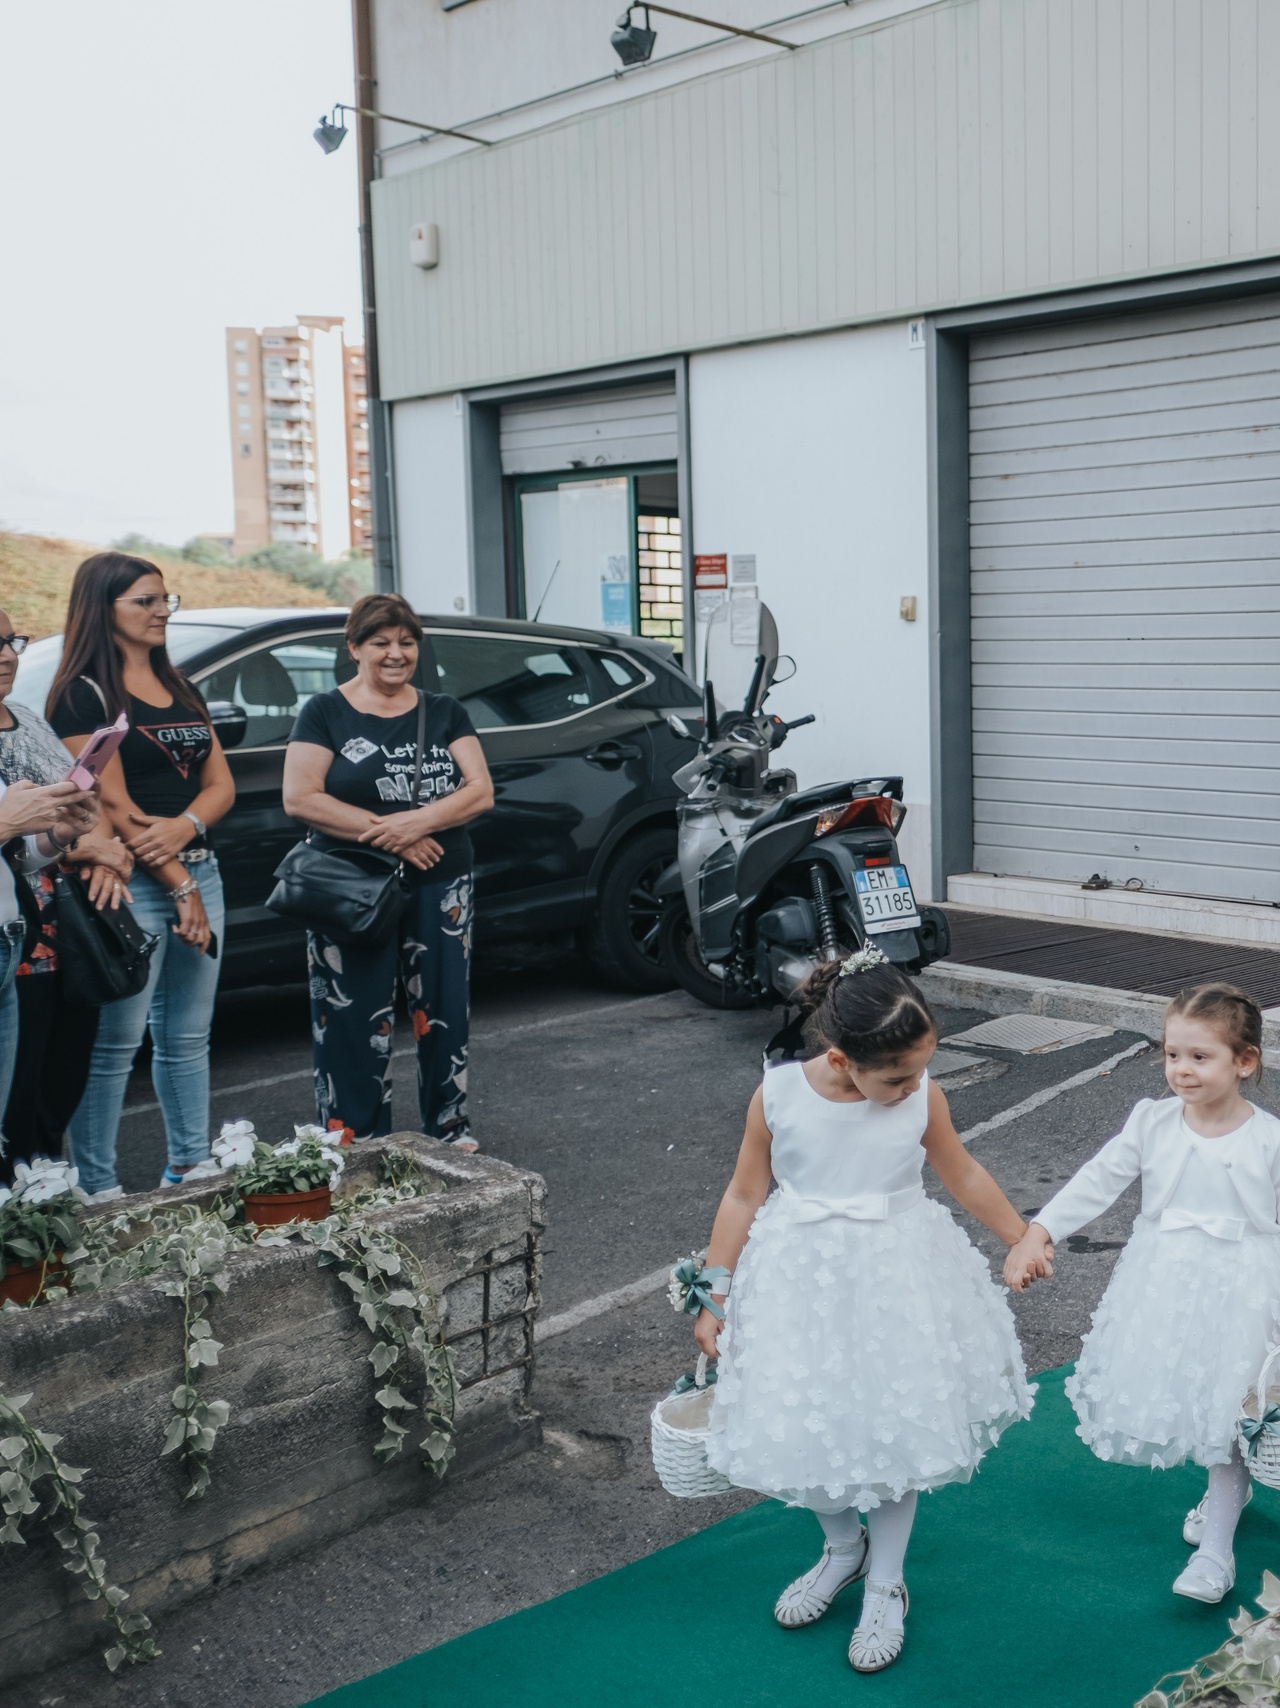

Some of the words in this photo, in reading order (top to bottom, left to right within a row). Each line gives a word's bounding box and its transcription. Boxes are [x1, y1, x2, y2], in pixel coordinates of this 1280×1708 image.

[157, 726, 210, 743] GUESS
[866, 870, 889, 890] EM
[862, 891, 913, 916] 31185
